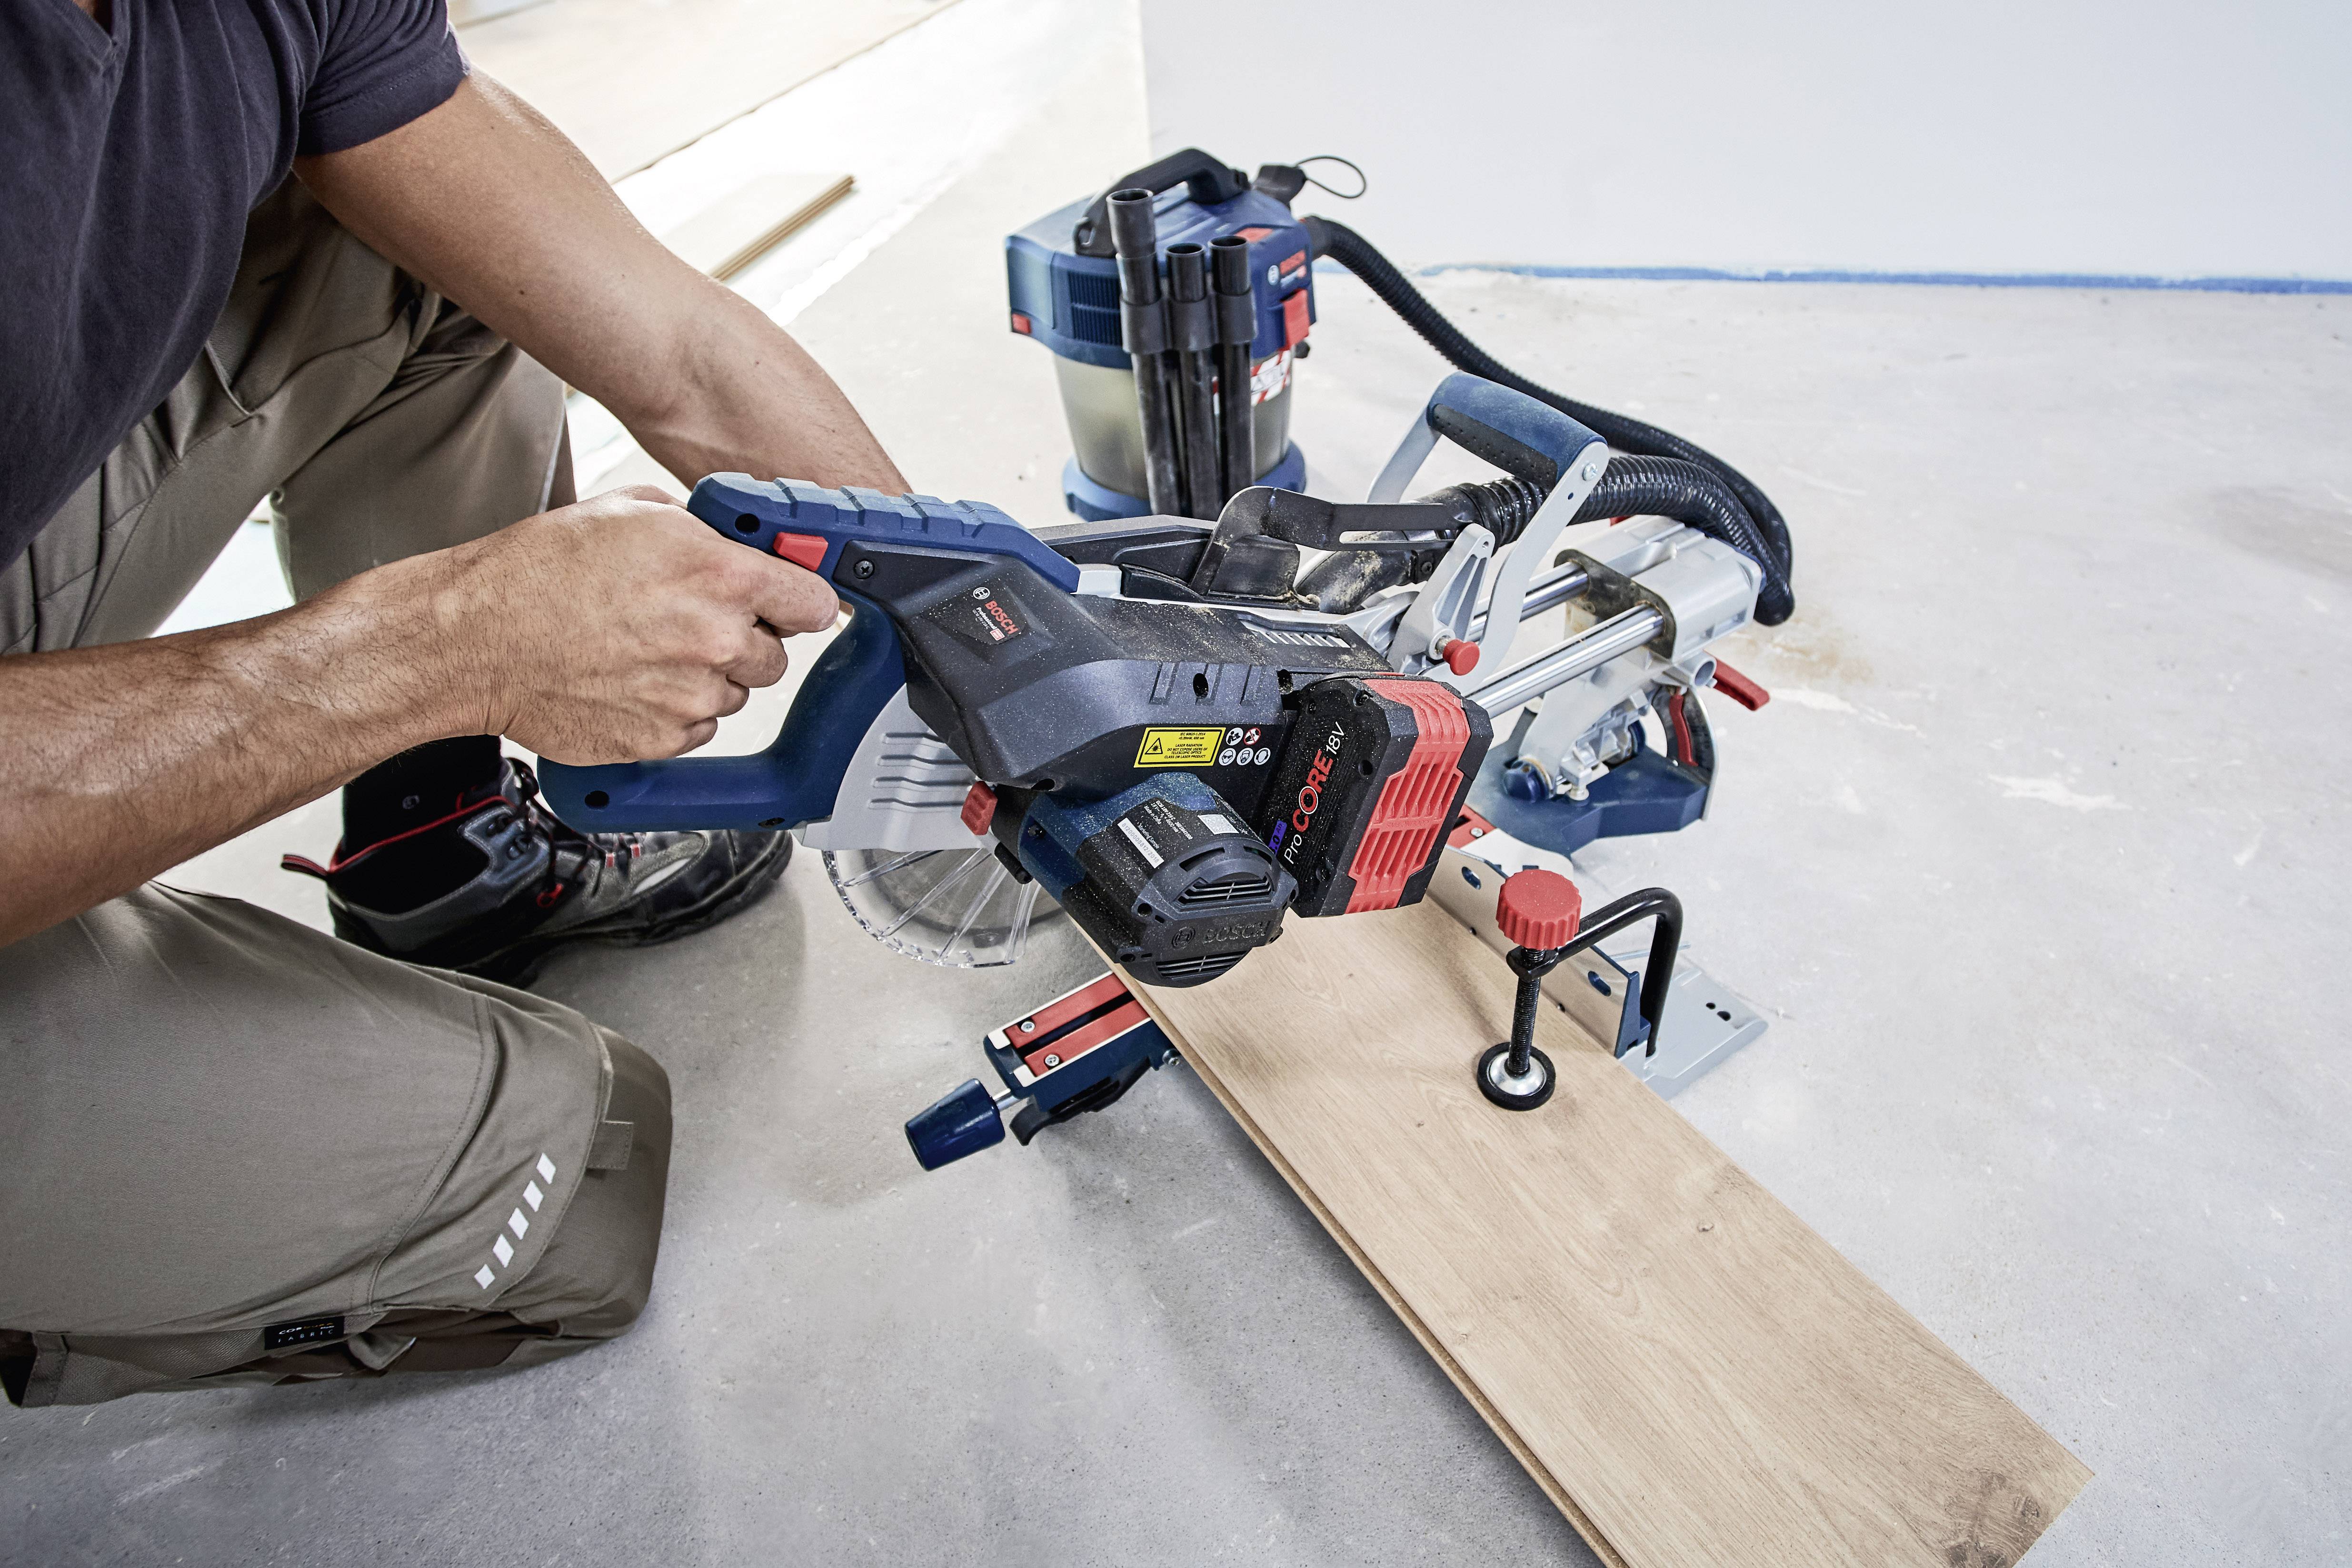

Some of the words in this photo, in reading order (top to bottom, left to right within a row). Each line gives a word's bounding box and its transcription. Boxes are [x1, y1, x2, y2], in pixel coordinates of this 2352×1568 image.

[976, 607, 997, 630] Professional
[985, 600, 1018, 634] BOSCH
[1326, 721, 1345, 754] 18V
